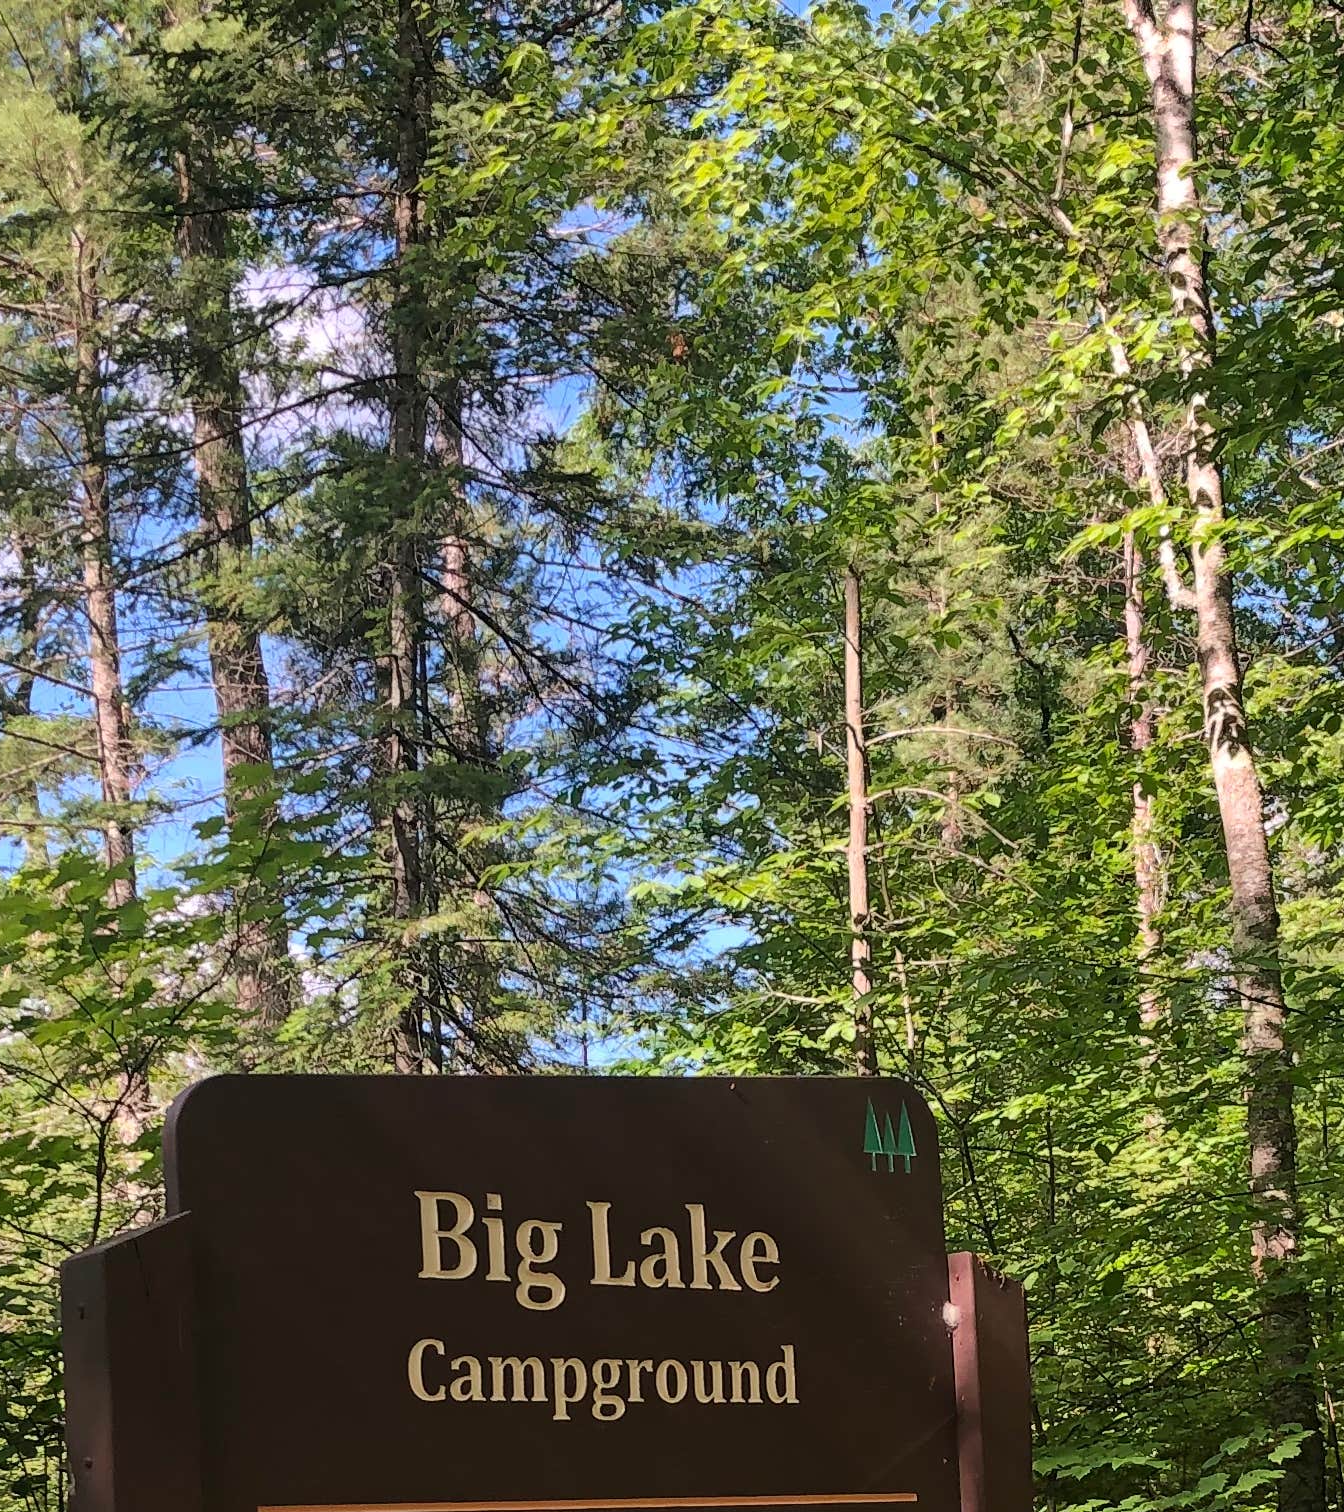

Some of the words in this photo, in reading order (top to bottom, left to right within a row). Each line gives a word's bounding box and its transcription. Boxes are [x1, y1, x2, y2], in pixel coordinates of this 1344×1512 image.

[414, 1190, 566, 1311] Big
[586, 1201, 780, 1292] Lake
[408, 1338, 800, 1420] Campground
